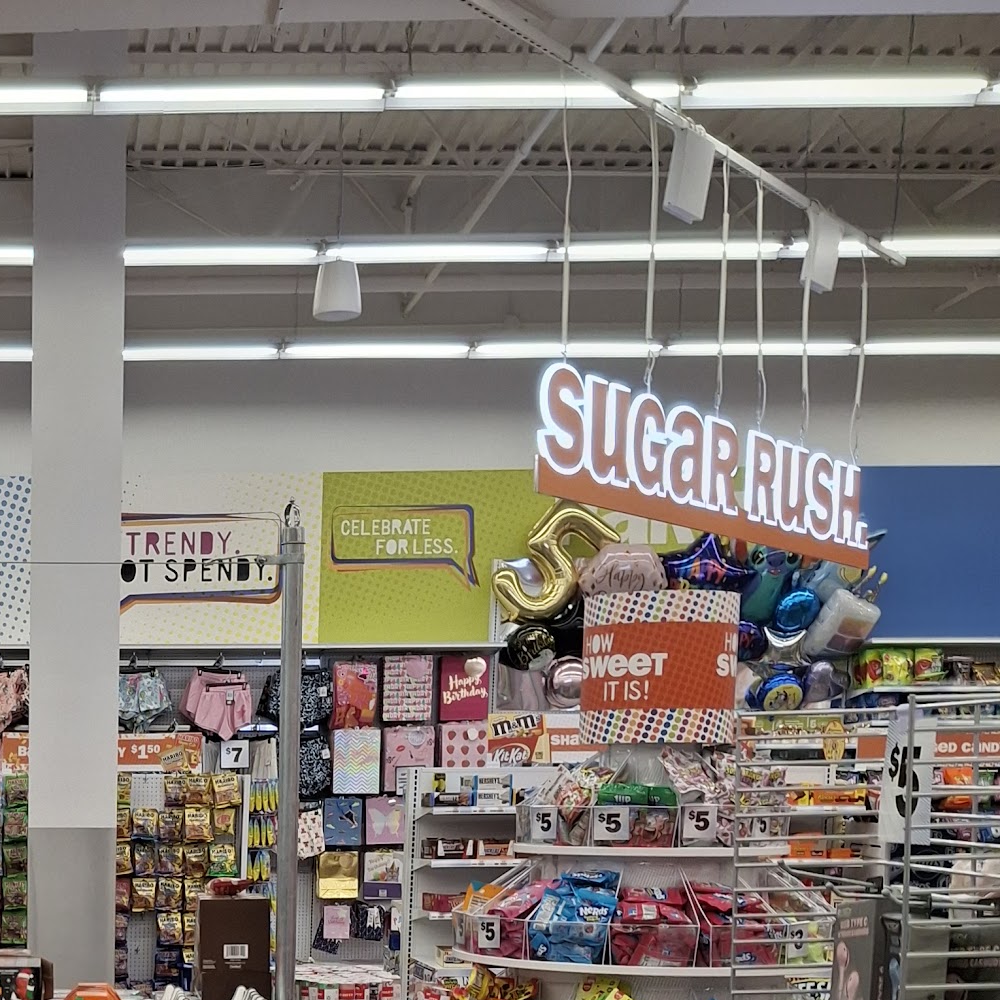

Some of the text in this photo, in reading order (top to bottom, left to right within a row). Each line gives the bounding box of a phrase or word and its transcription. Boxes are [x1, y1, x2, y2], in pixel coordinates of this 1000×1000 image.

[341, 519, 431, 536] CELEBRATE
[126, 531, 241, 555] TRENDY.
[376, 538, 458, 555] FOR LESS.
[165, 557, 273, 582] SPENDY.
[596, 566, 645, 589] Happy
[586, 633, 614, 653] HOW
[448, 673, 482, 690] Happy
[603, 680, 649, 701] IT IS!
[442, 686, 489, 705] Birthday
[225, 747, 243, 763] $7
[478, 777, 500, 785] HERSHEY'S
[888, 741, 922, 818] $5
[536, 811, 552, 832] $5
[598, 813, 622, 833] $5
[688, 810, 710, 831] $5
[480, 921, 496, 941] $5
